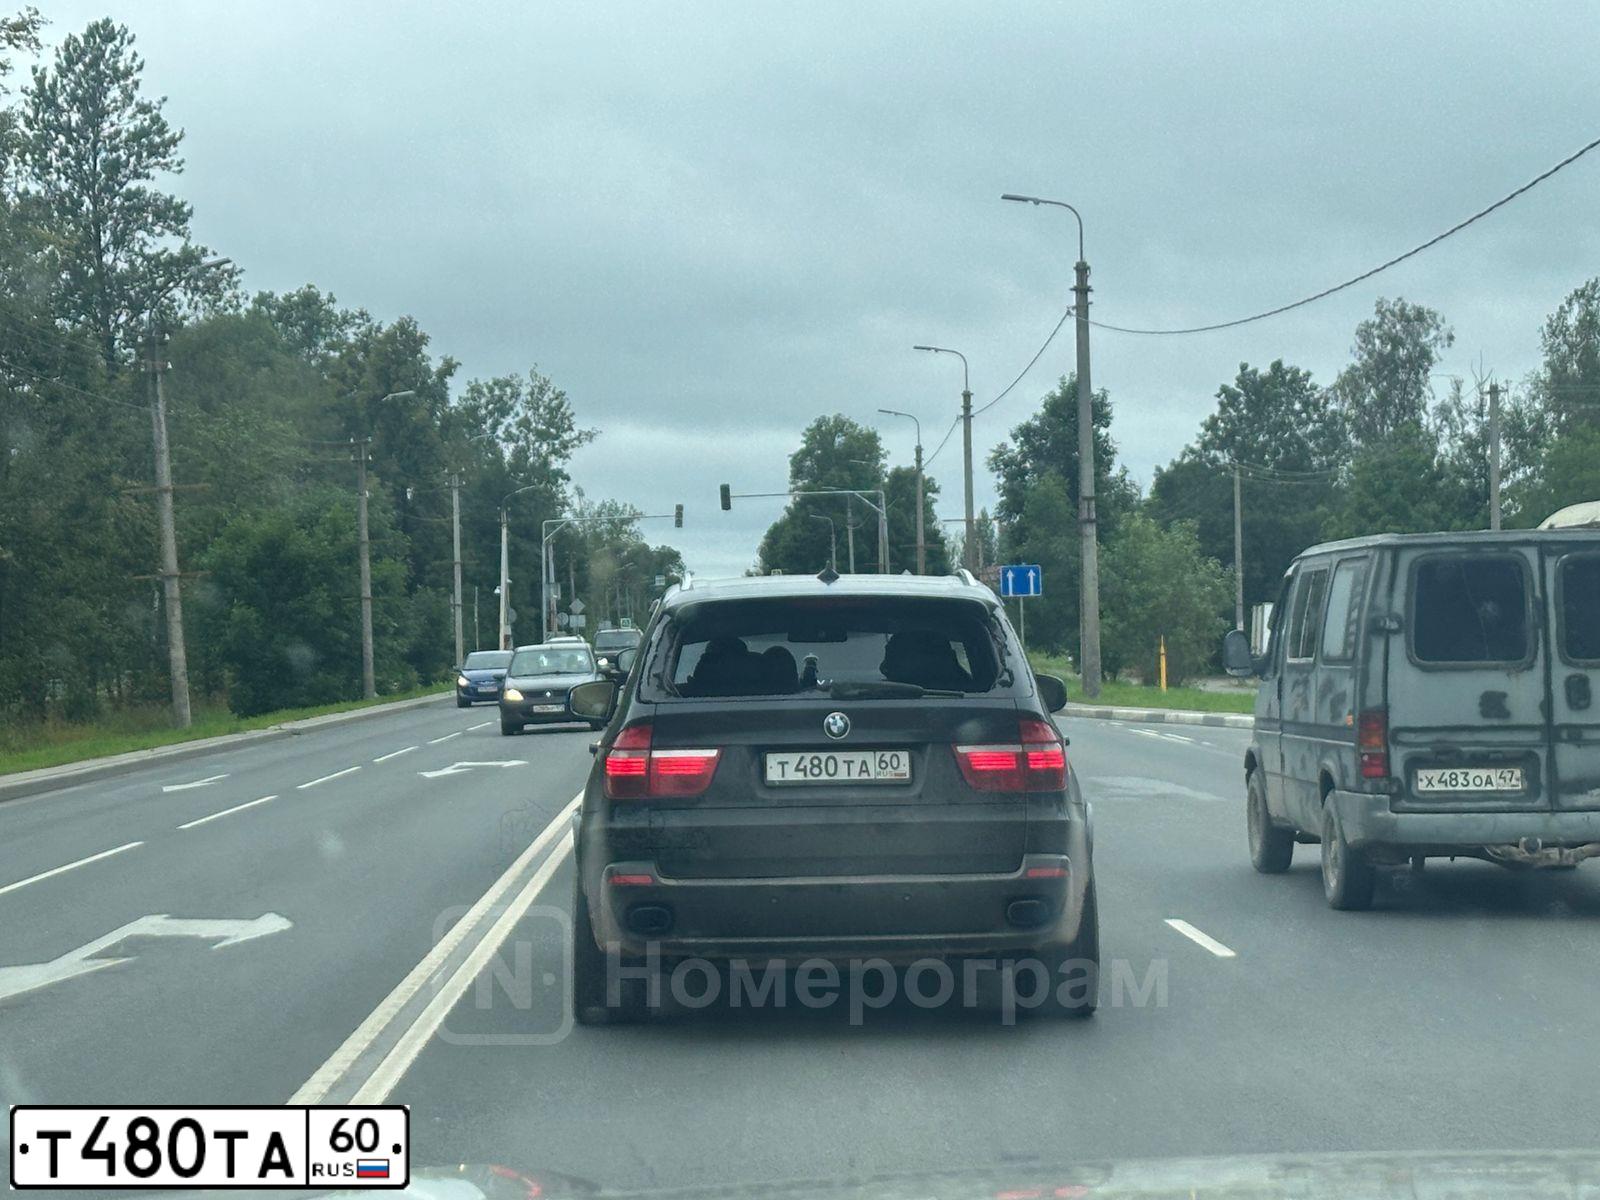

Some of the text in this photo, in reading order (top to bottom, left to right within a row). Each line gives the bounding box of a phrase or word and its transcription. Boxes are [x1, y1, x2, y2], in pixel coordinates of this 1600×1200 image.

[777, 753, 901, 778] Т480ТА 60
[1425, 770, 1515, 788] Х483ОА 47
